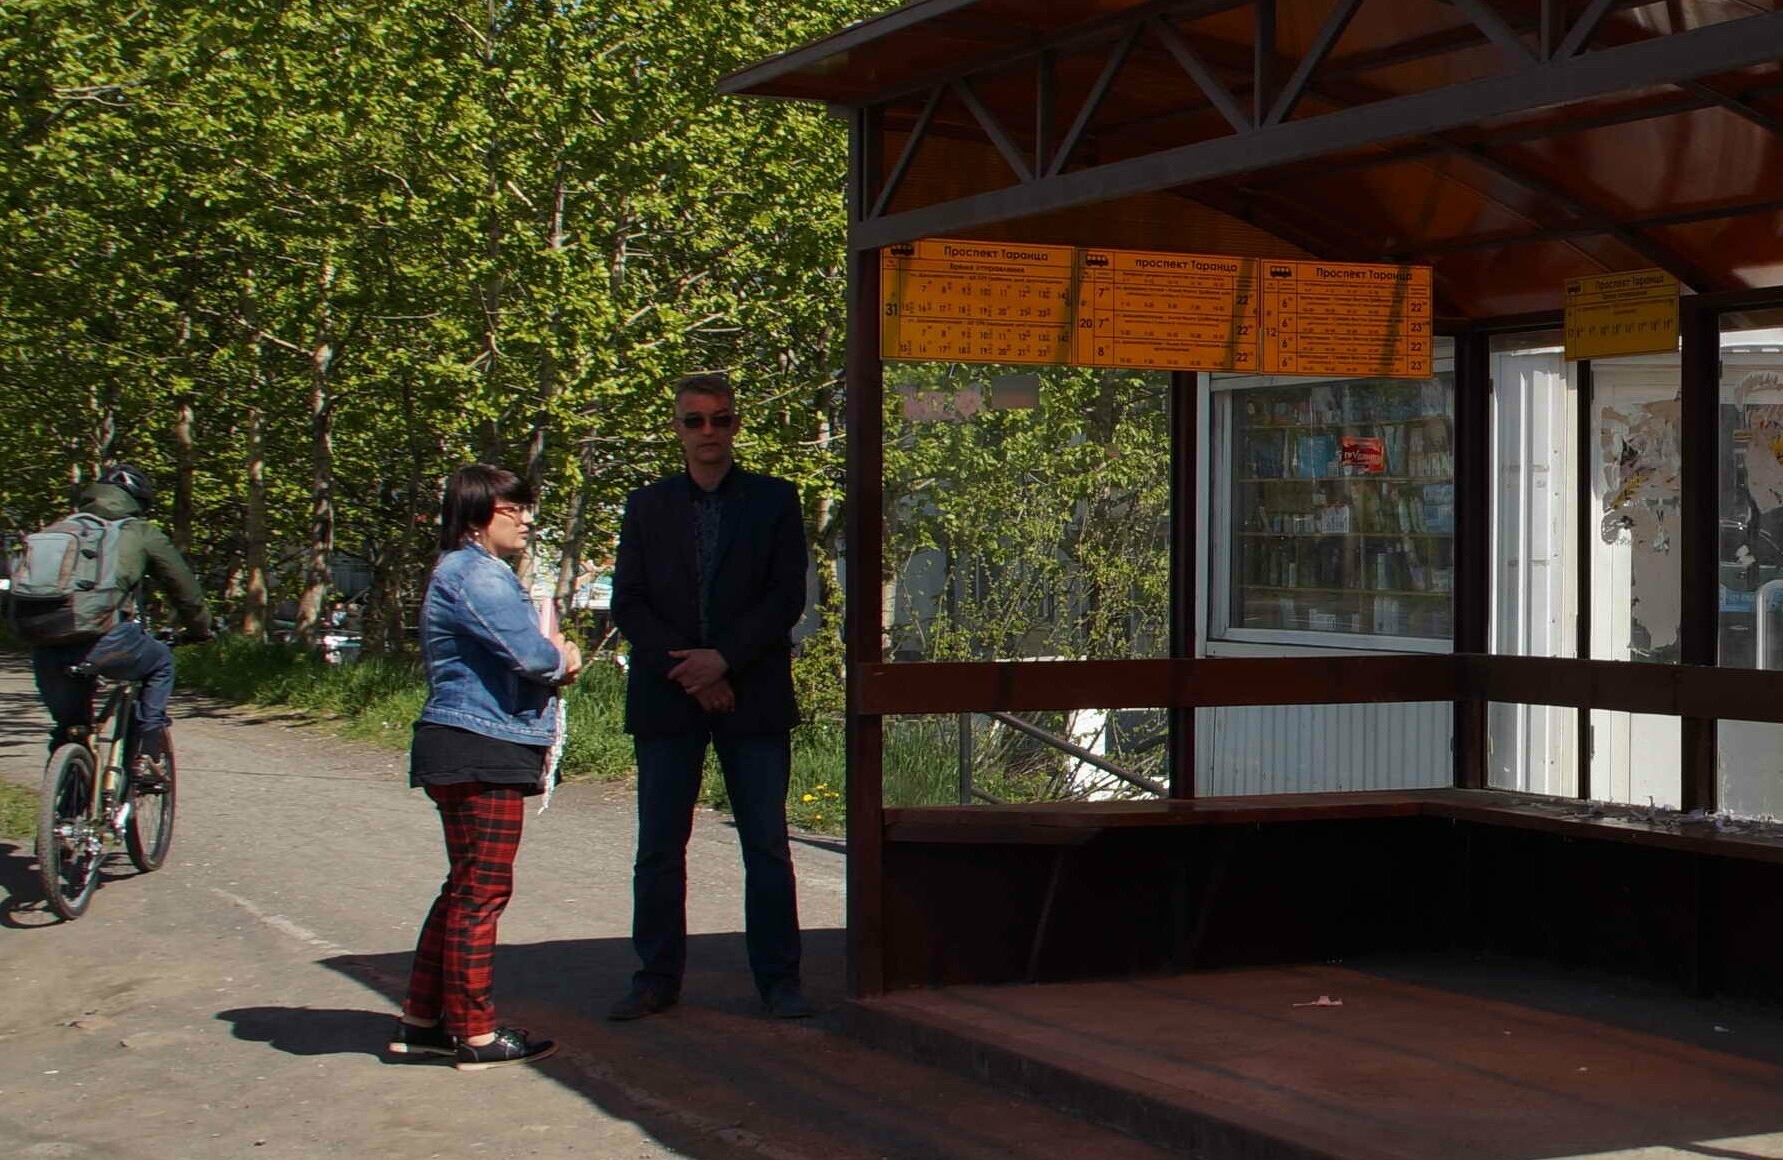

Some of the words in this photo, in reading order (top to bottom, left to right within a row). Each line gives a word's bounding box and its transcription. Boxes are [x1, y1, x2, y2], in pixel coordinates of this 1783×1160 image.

[944, 245, 997, 259] Проспект
[1002, 249, 1049, 261] Таранца
[1135, 258, 1188, 270] проспект
[1191, 260, 1238, 273] Таранца
[1316, 267, 1367, 279] Проспект
[1368, 270, 1413, 281] Таранца
[885, 303, 898, 316] 31
[1079, 318, 1093, 329] 20
